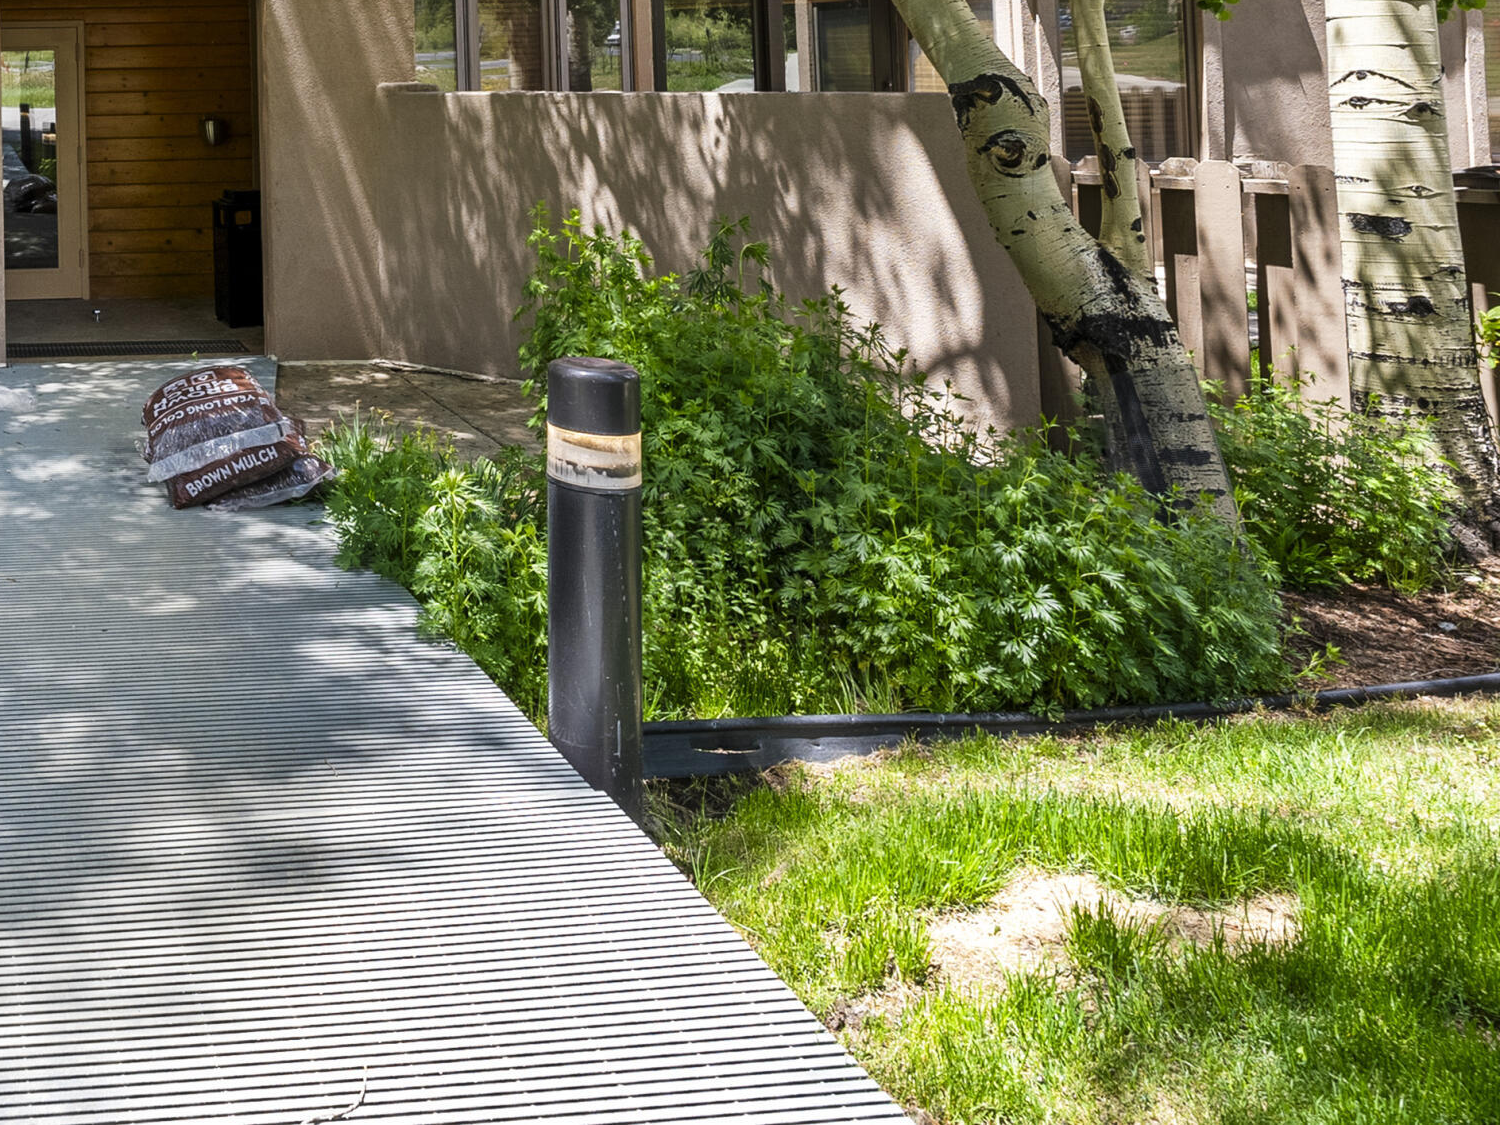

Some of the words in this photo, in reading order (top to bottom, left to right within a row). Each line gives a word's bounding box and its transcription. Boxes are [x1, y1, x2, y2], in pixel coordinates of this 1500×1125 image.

[186, 400, 221, 415] LONG
[223, 394, 256, 406] YEAR
[185, 465, 231, 497] BROWN
[231, 446, 278, 474] MULCH
